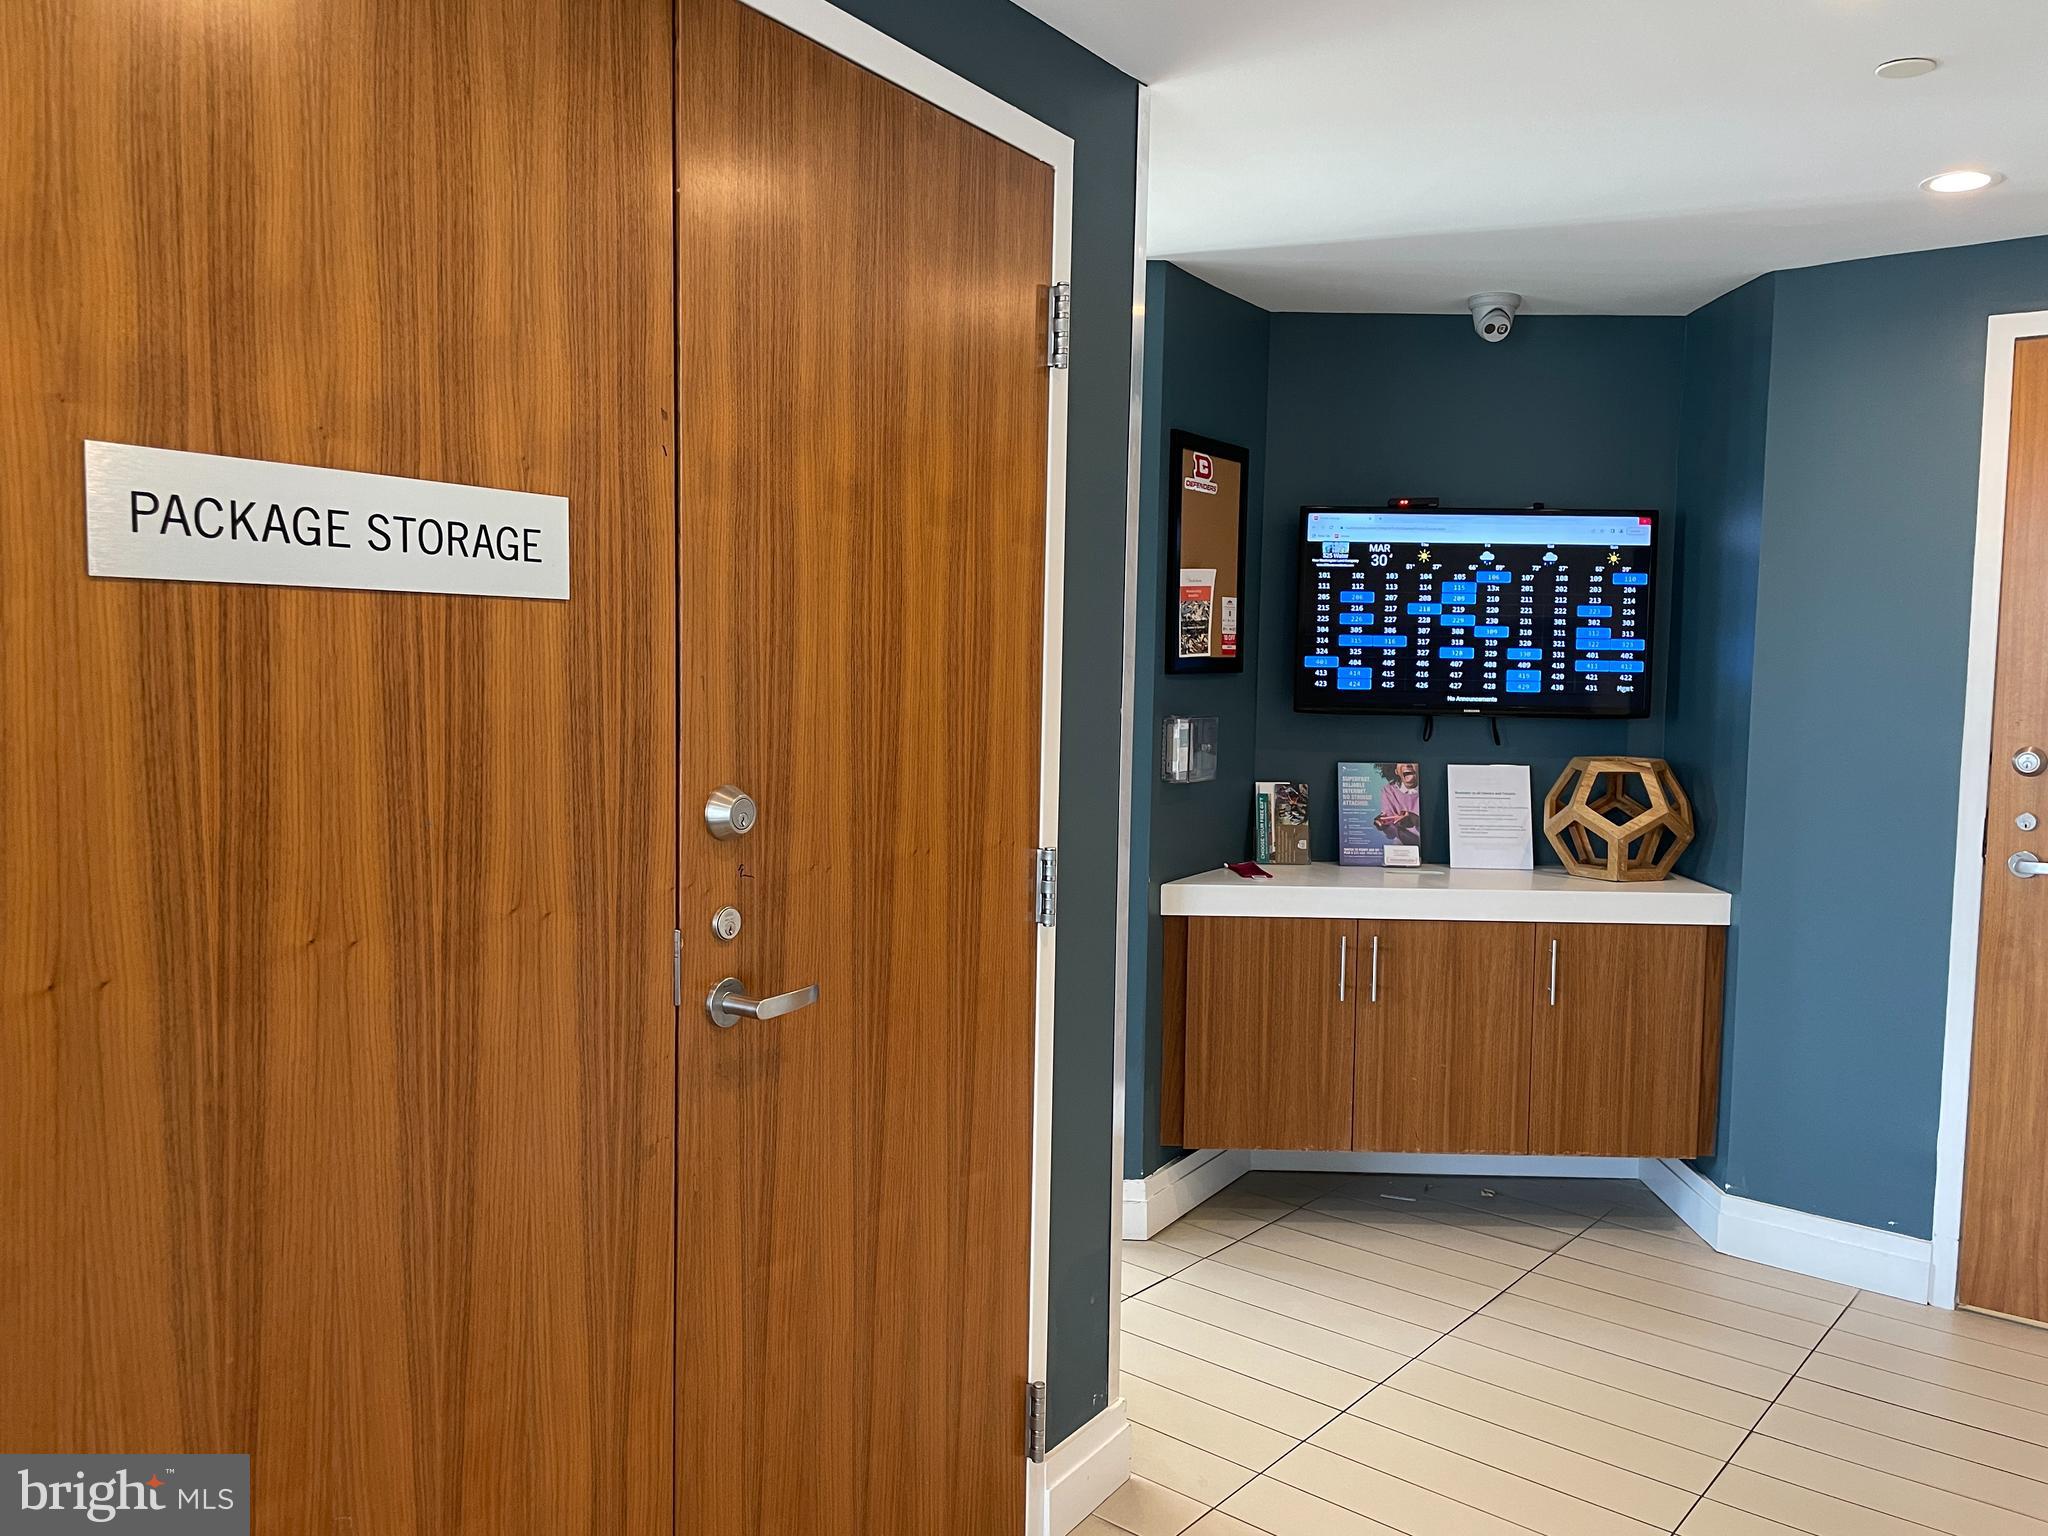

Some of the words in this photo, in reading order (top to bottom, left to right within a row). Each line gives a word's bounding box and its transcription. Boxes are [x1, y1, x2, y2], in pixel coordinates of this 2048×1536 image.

[1185, 480, 1217, 492] DEFENDERS
[129, 490, 351, 549] PACKAGE
[367, 513, 543, 564] STORAGE
[1369, 543, 1391, 553] MAR
[1370, 554, 1388, 567] 30
